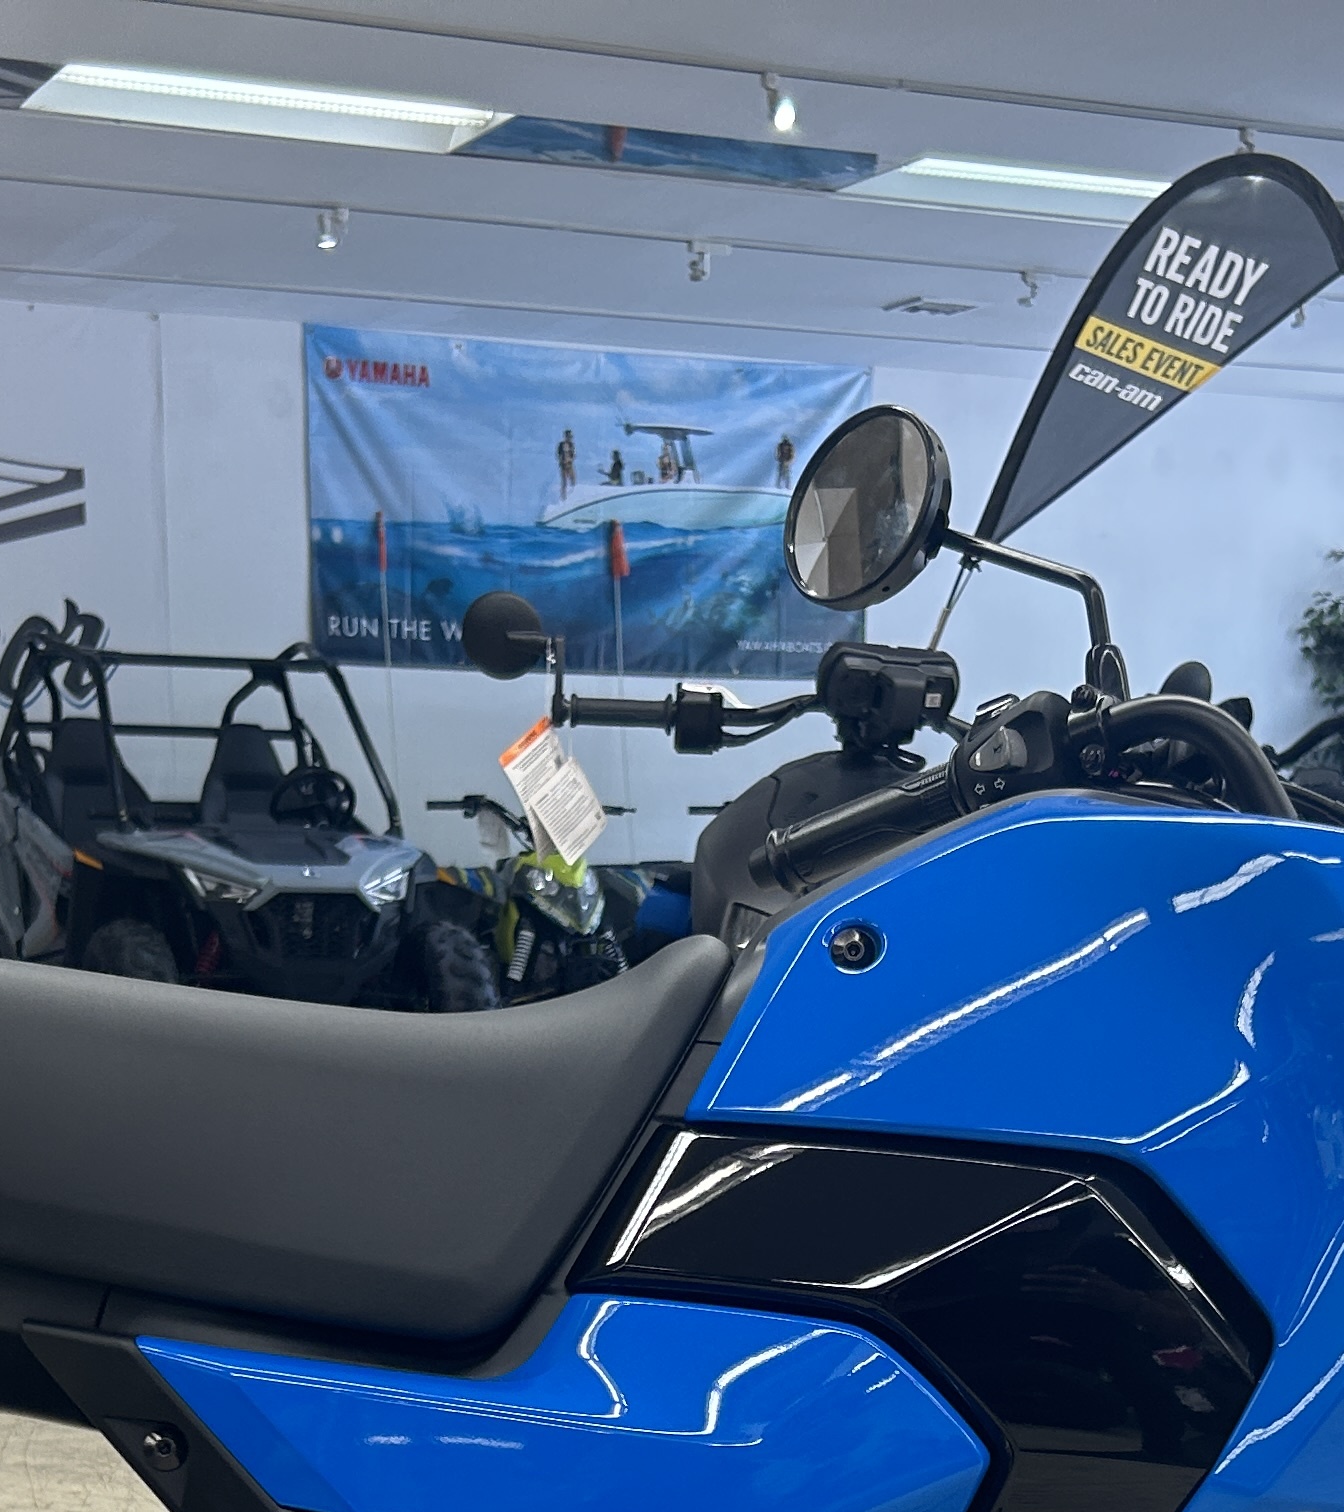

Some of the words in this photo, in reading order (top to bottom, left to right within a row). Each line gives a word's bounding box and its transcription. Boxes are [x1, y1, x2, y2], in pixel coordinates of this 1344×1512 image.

[1144, 226, 1269, 307] READY
[1126, 277, 1170, 327] TO
[1164, 299, 1244, 354] RIDE
[346, 358, 430, 388] YAMAHA
[1086, 325, 1145, 365] SALES
[1141, 346, 1204, 389] EVENT
[1068, 363, 1163, 412] can-am
[327, 615, 379, 638] RUN
[388, 618, 432, 641] THE
